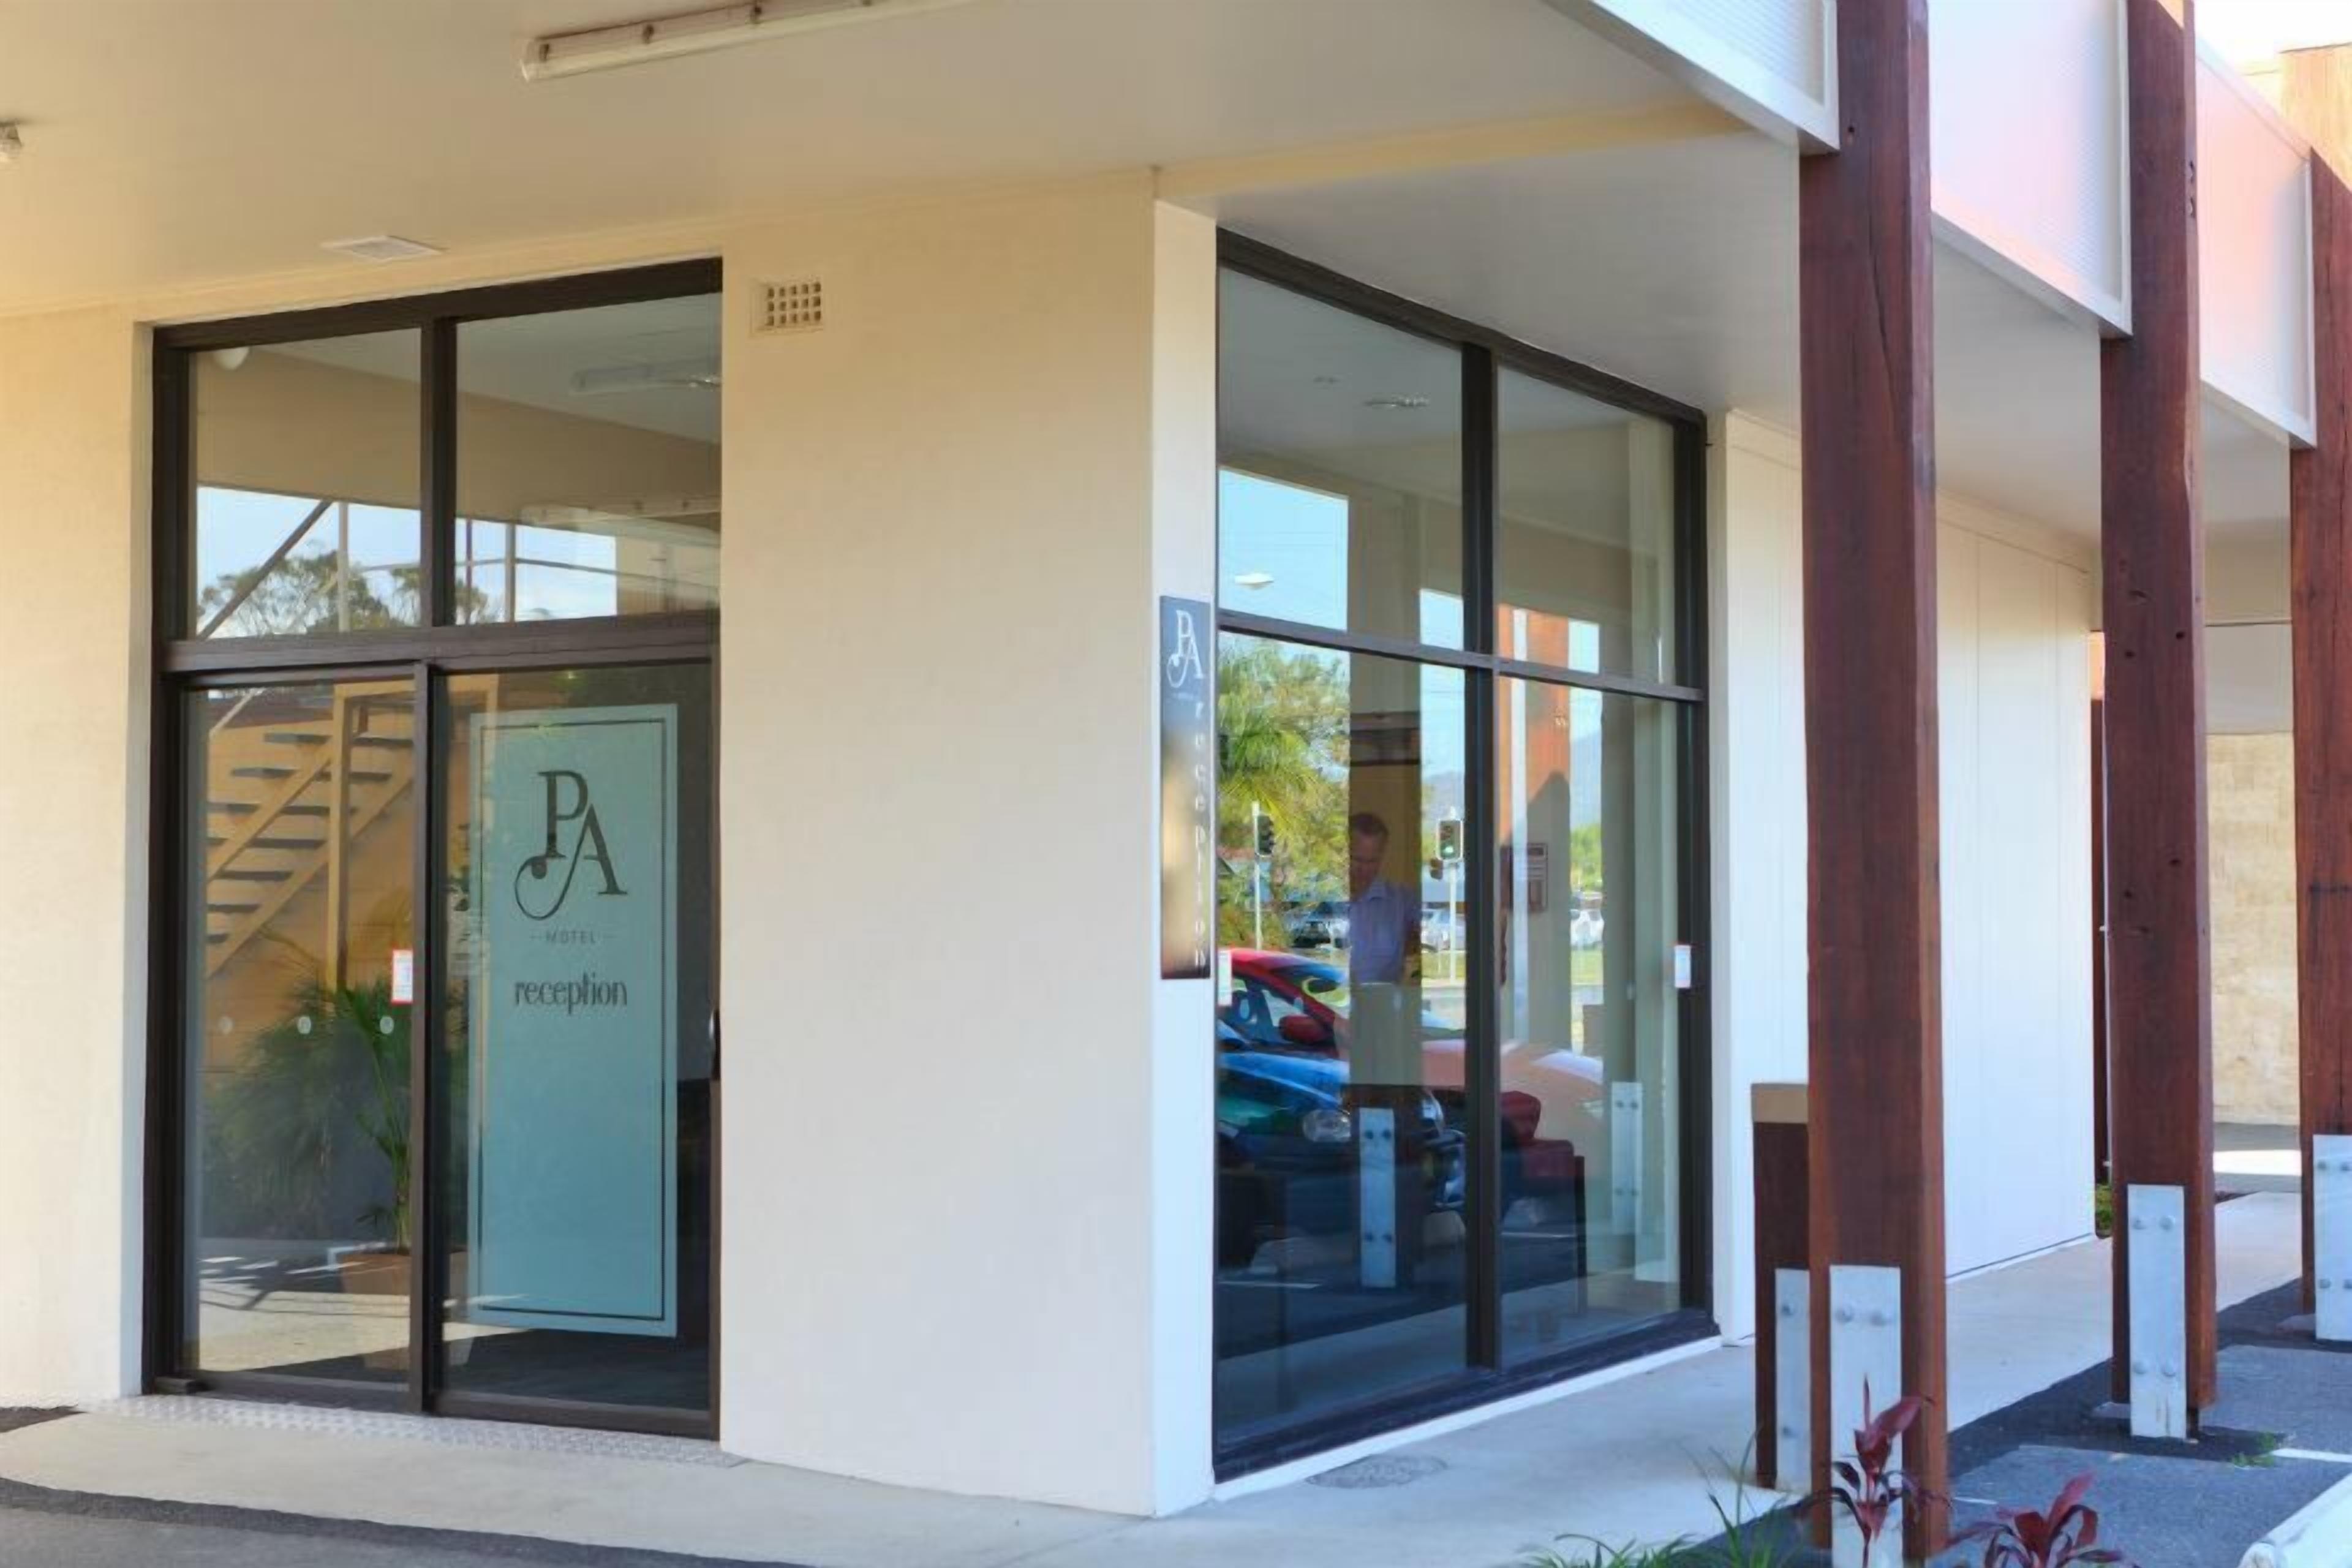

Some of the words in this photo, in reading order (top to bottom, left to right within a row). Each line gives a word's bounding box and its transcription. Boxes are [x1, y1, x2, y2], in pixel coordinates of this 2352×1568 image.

[514, 769, 628, 921] PA
[546, 930, 596, 944] MOTEL
[514, 971, 628, 1014] reception
